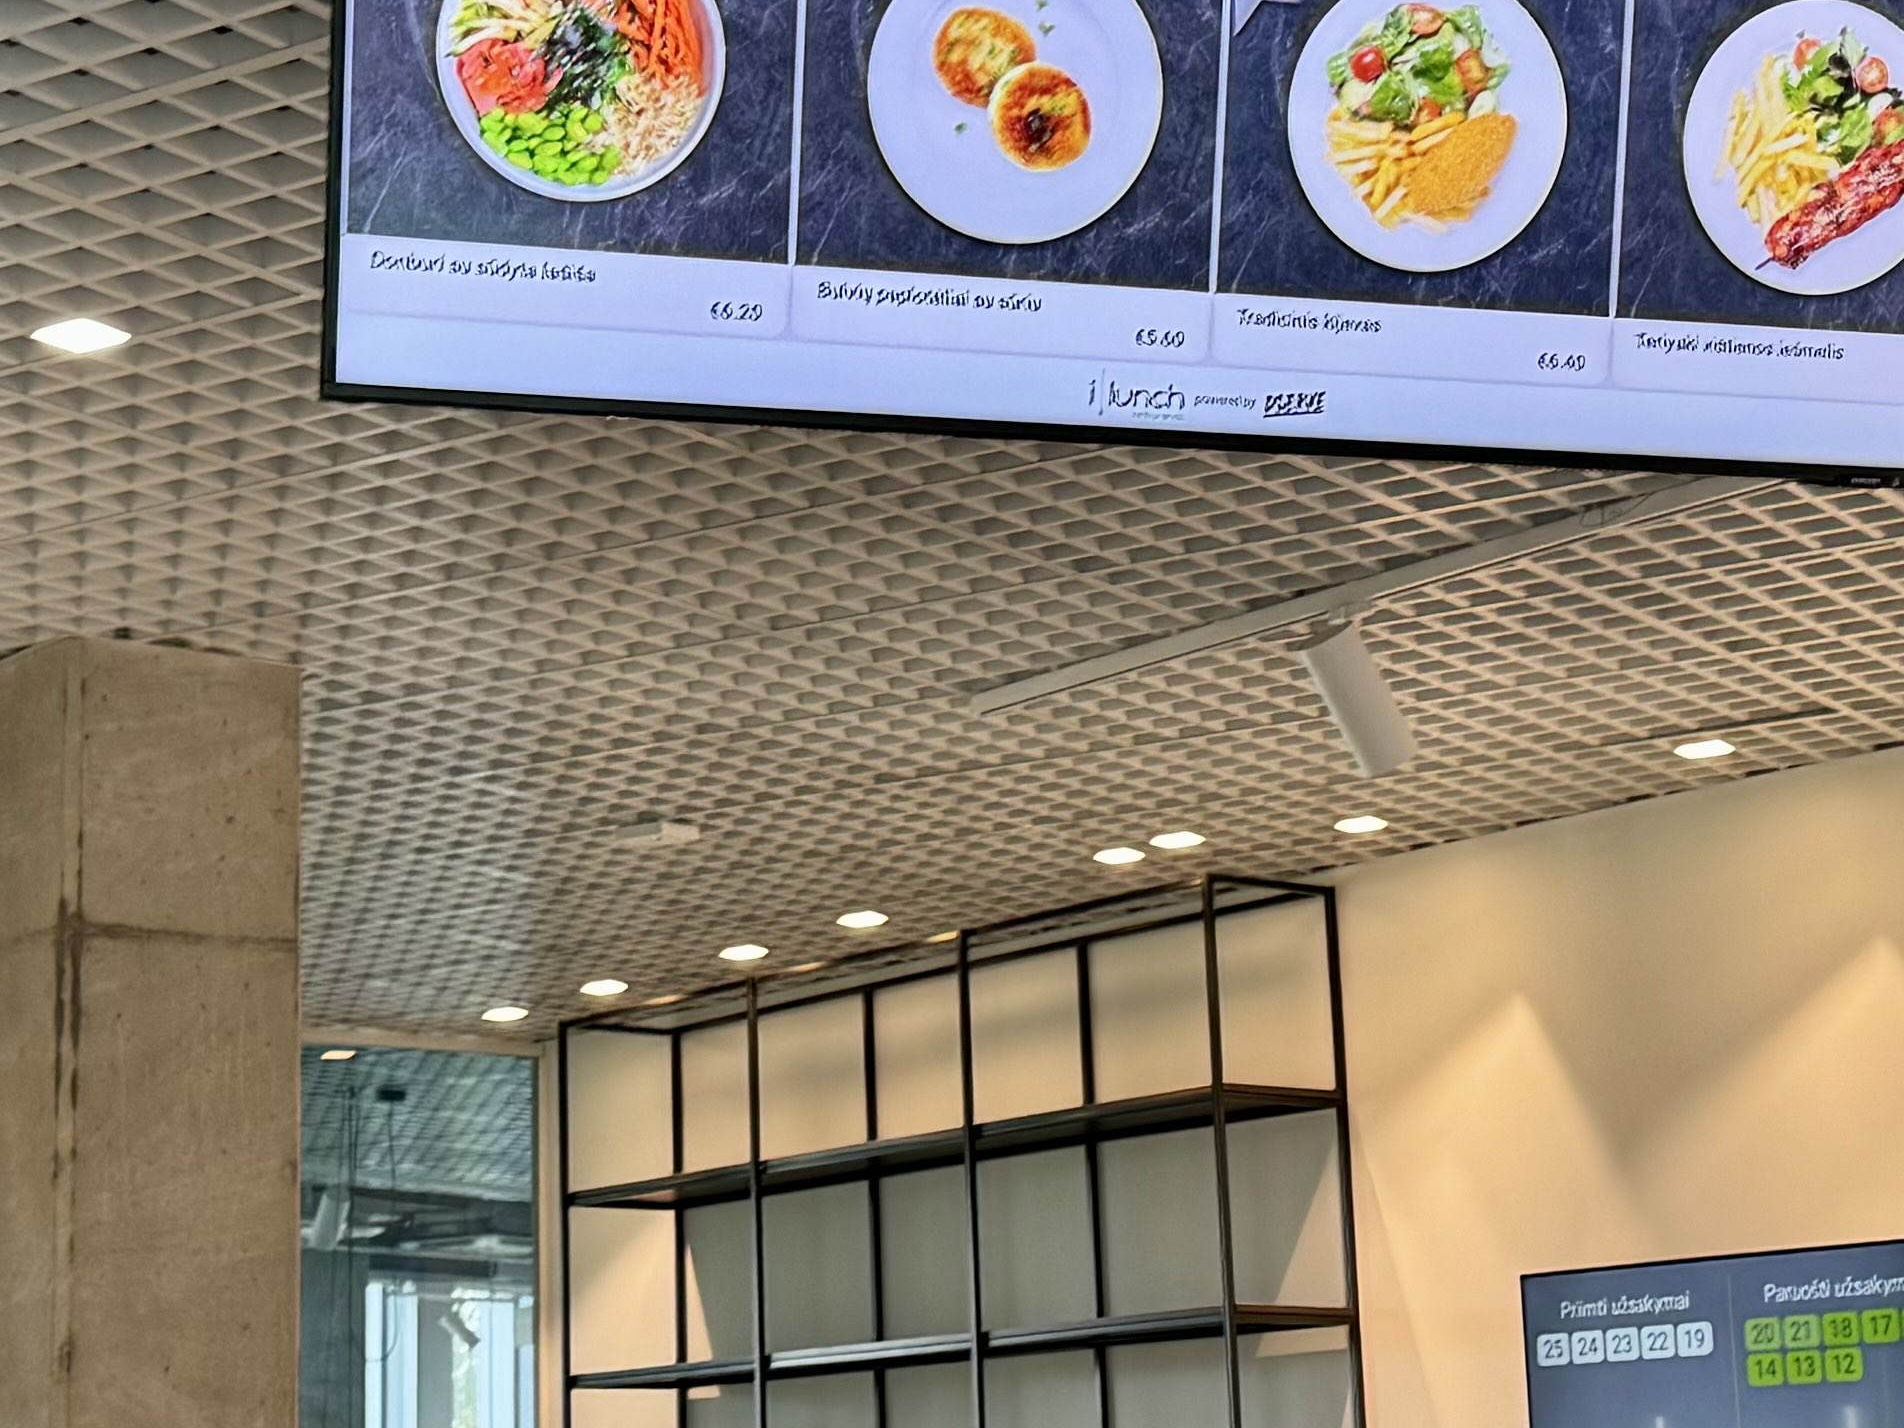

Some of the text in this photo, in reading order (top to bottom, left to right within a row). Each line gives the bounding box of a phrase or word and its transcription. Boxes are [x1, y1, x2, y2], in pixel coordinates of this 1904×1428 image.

[369, 249, 446, 274] Donburi
[448, 258, 473, 276] su
[710, 301, 763, 322] €6.20
[973, 294, 995, 310] su
[1107, 379, 1186, 411] lunch
[1559, 1289, 1691, 1319] Priimti užsakymai
[1763, 1278, 1831, 1303] Paruošti
[1870, 1314, 1892, 1336] 17
[1543, 1328, 1706, 1359] 25 24 23 22 19
[1754, 1353, 1856, 1380] 14 13 12
